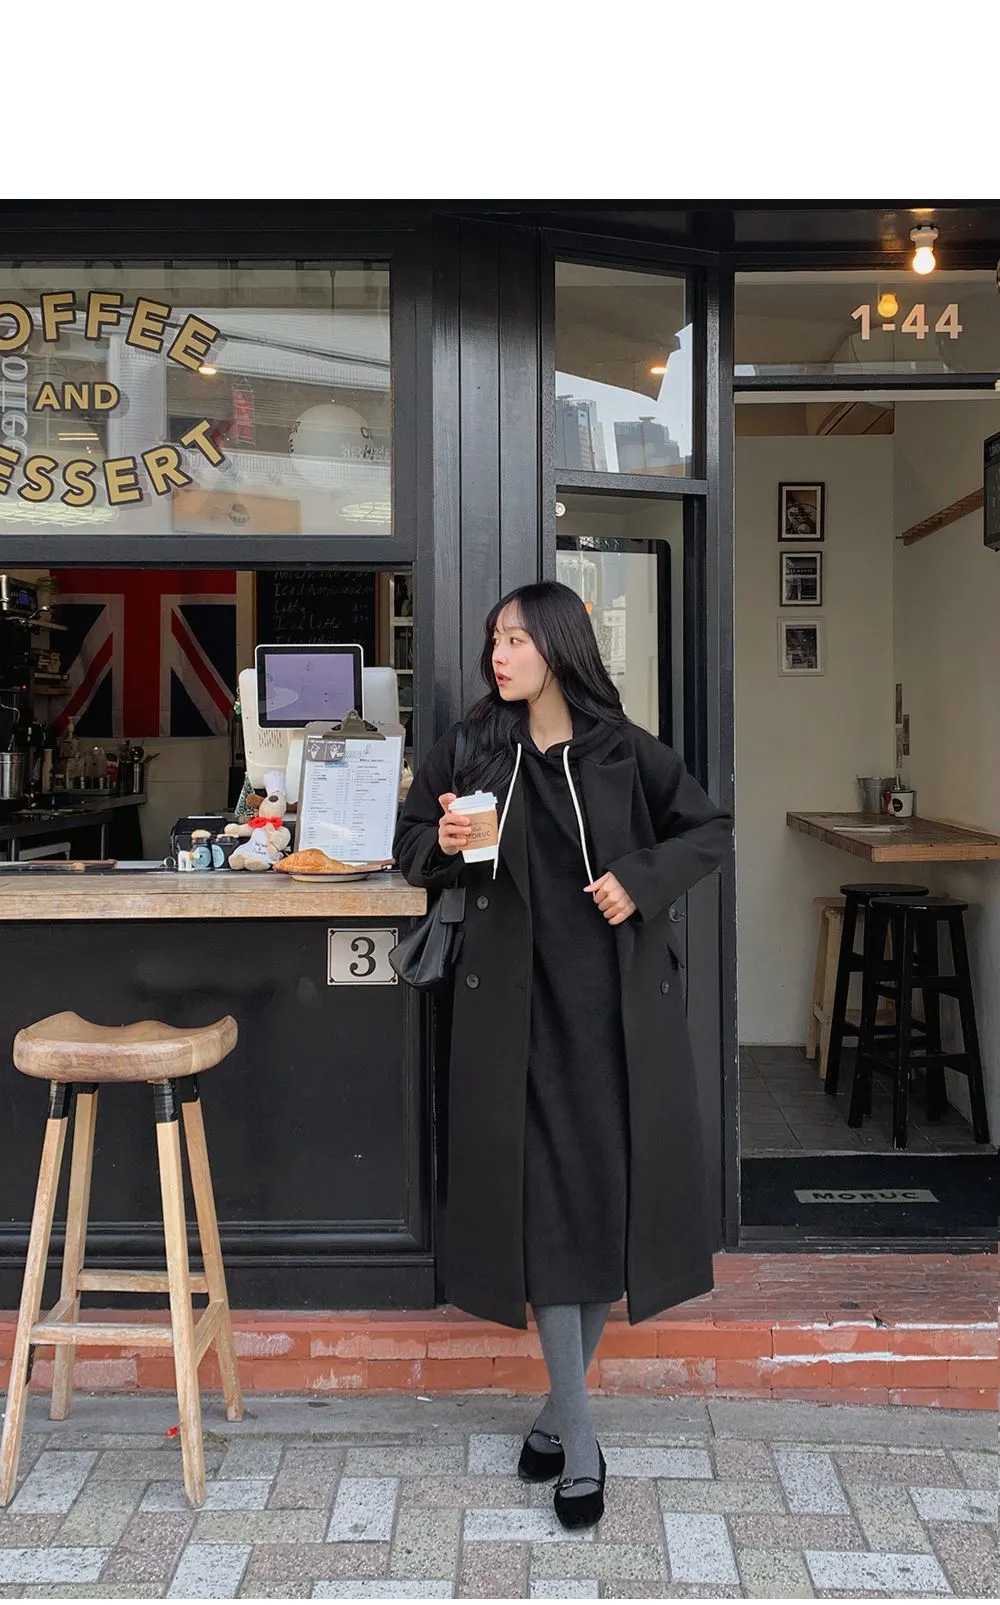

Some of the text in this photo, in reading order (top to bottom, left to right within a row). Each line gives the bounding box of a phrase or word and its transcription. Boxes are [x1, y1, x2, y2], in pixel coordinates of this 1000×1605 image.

[850, 303, 964, 340] 1-44
[32, 381, 121, 412] AND
[349, 936, 377, 978] 3
[812, 1191, 920, 1200] MORUC
